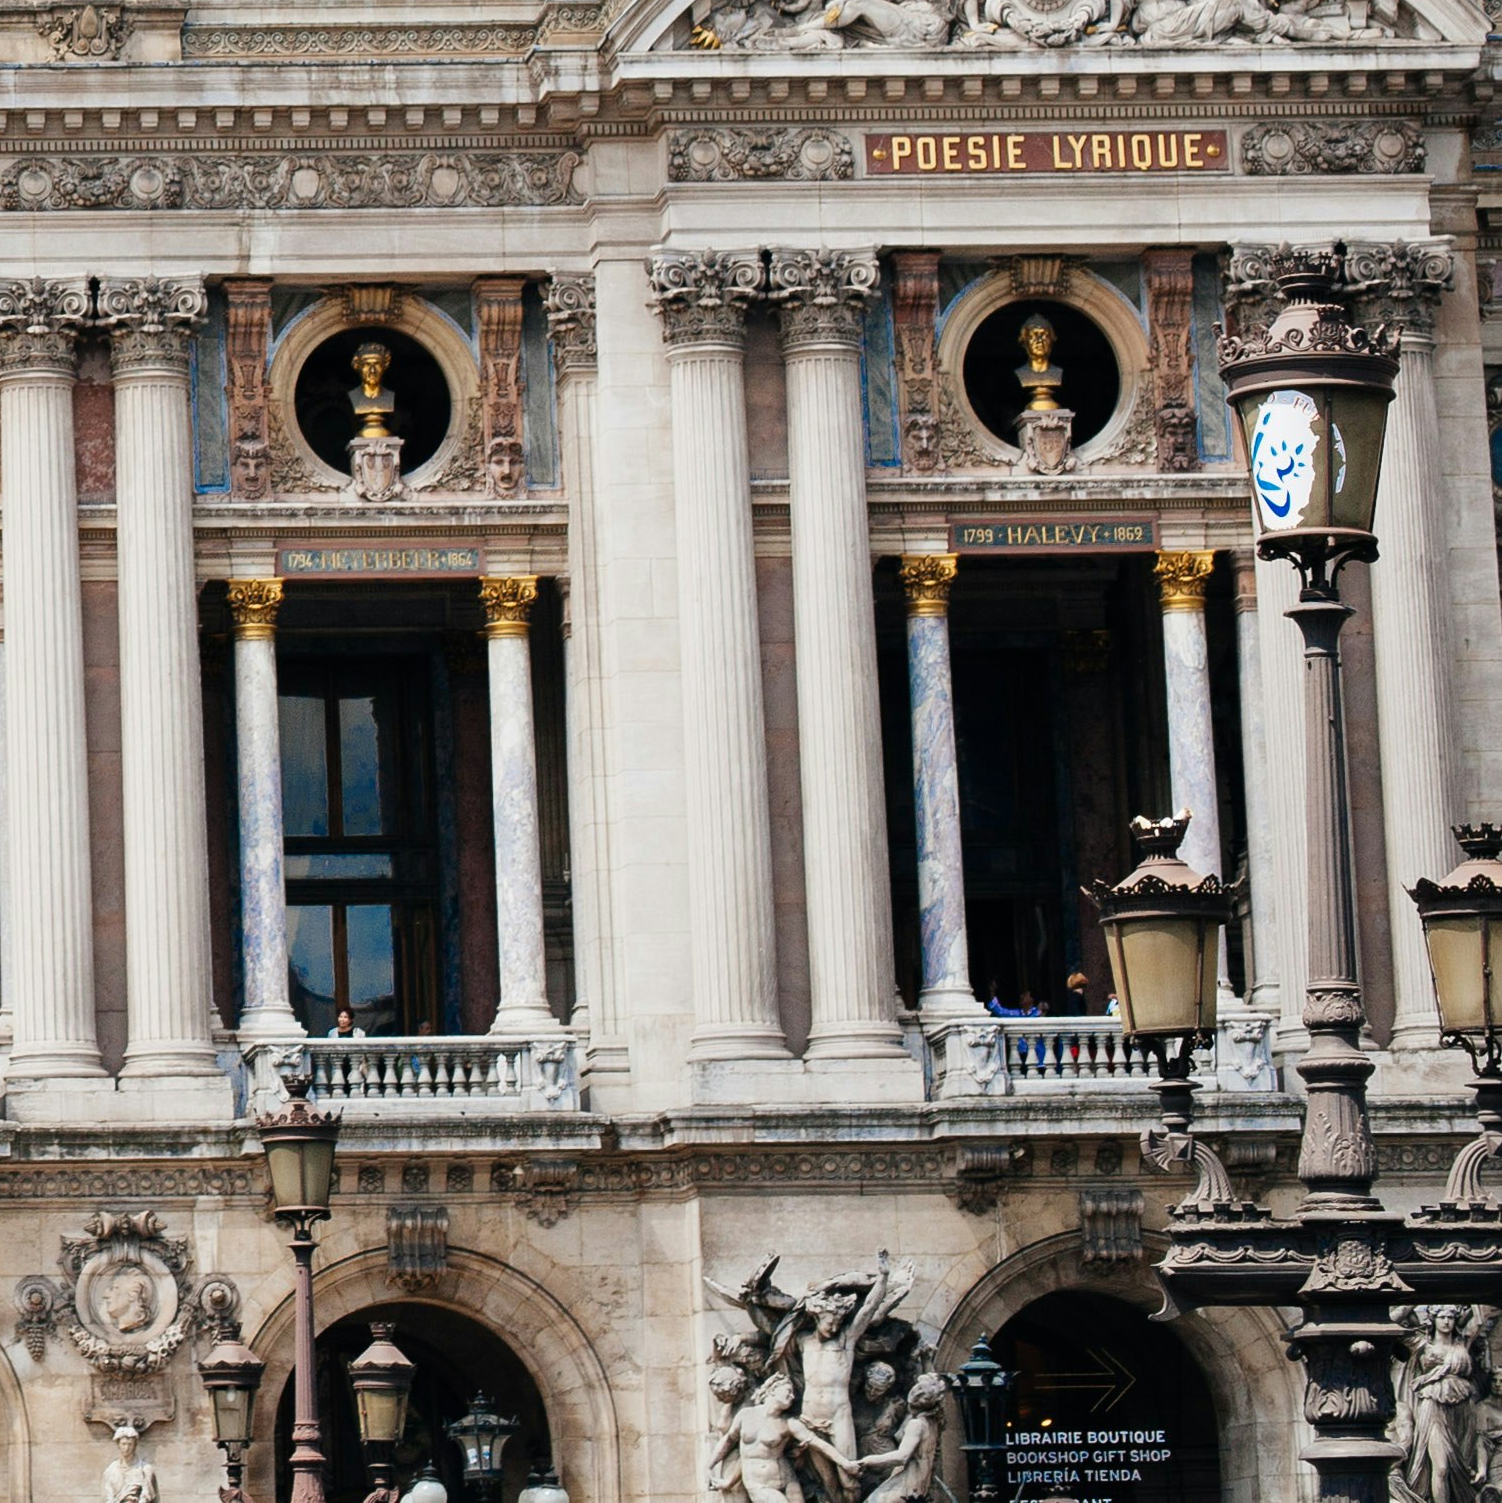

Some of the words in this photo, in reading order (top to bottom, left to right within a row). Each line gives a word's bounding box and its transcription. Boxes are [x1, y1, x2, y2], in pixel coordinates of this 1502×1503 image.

[892, 135, 1027, 170] POESIE
[1053, 133, 1204, 171] LYRIQUE
[963, 528, 993, 544] 1799
[1007, 525, 1101, 545] HALEVY
[1113, 526, 1143, 541] 1862
[288, 553, 313, 568] 1794
[447, 551, 473, 566] 1864
[1005, 1432, 1082, 1445] LIBRAIRIE
[1087, 1430, 1166, 1444] BOUTIQUE
[1006, 1451, 1089, 1464] BOOKSHOP
[1093, 1450, 1126, 1463] GIFT
[1130, 1449, 1171, 1462] SHOP
[1008, 1467, 1080, 1483] LIBRERÍA
[1084, 1469, 1142, 1482] TIENDA
